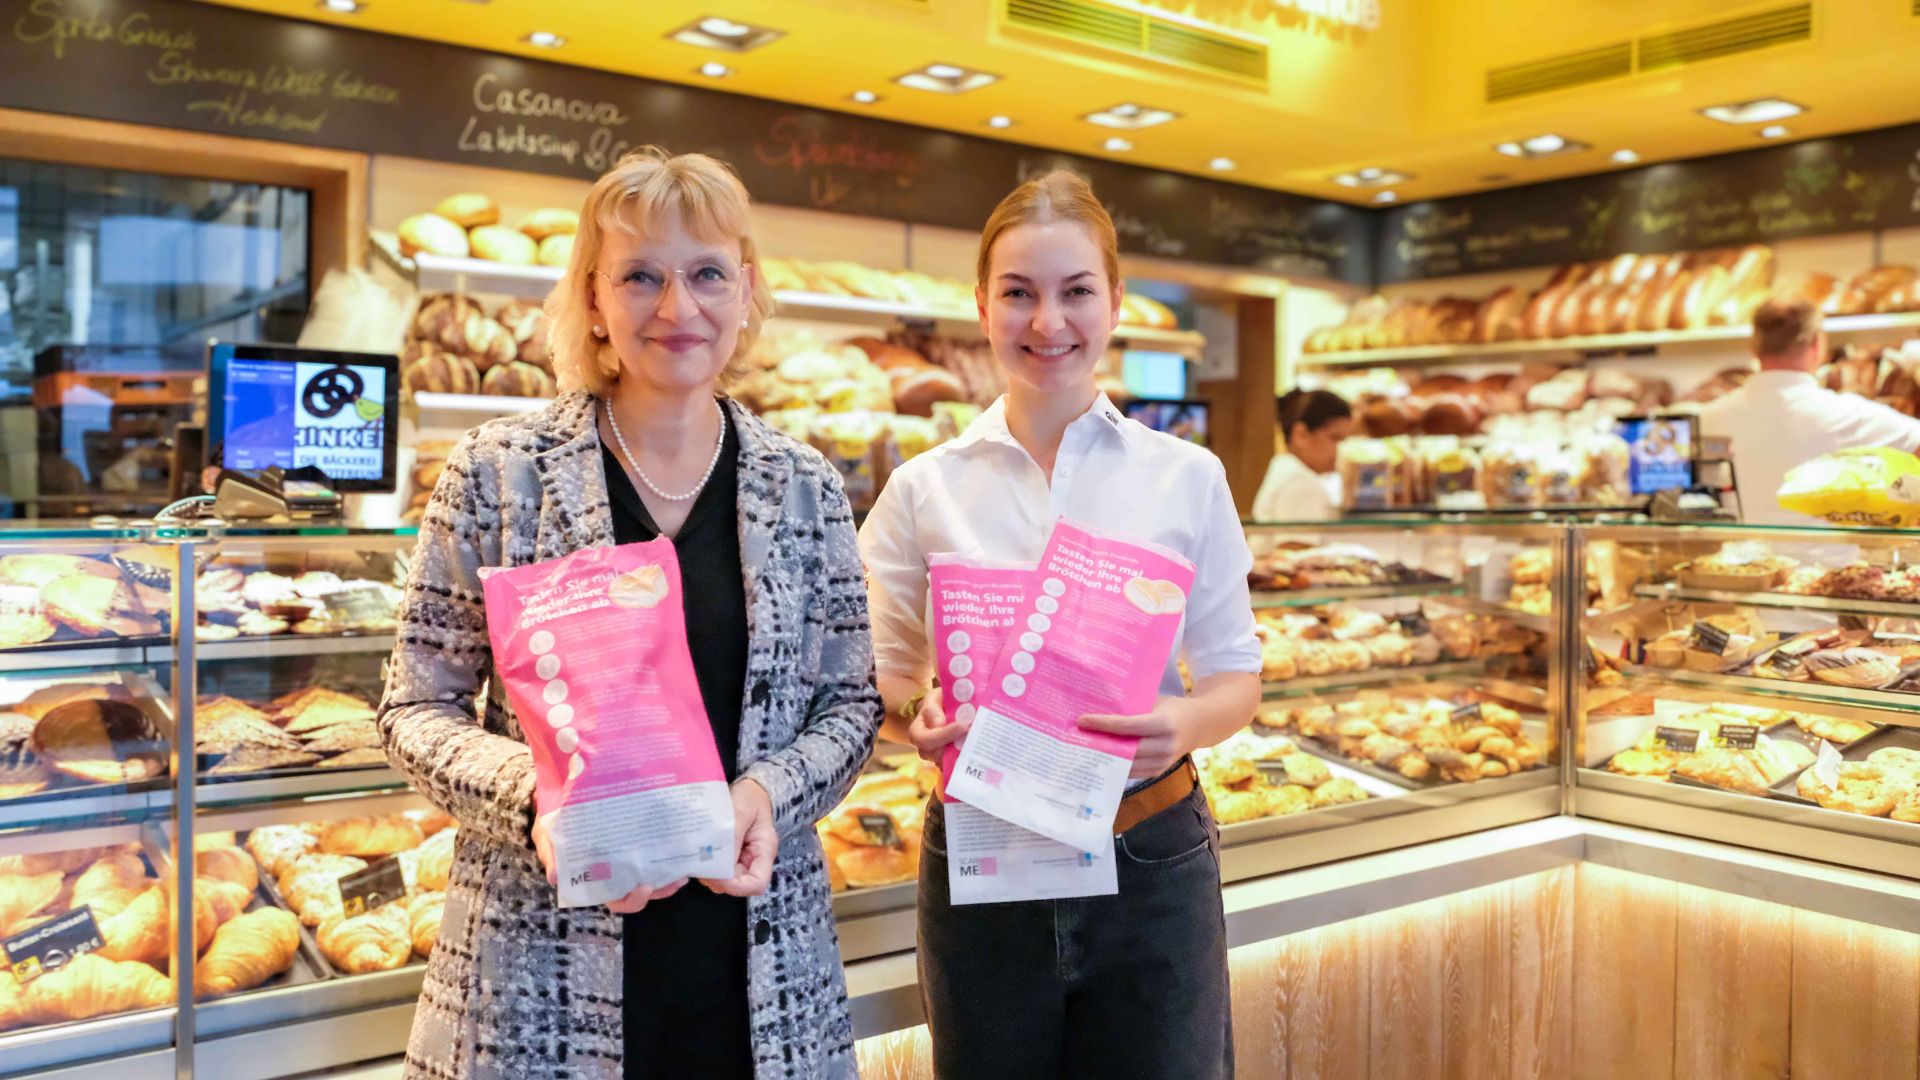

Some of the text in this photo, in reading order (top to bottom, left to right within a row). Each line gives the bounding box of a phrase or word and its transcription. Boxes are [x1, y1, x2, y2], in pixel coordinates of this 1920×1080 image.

[473, 72, 630, 125] Casanova
[322, 453, 377, 466] BÄCKEREI
[1057, 543, 1094, 567] Tasten
[1097, 559, 1116, 571] Sie
[1118, 565, 1144, 578] mal
[1052, 554, 1095, 578] wieder
[1097, 569, 1122, 583] Ihre
[565, 578, 589, 592] Sie
[1047, 562, 1121, 594] Brötchen ab
[941, 589, 980, 603] Tasten
[983, 592, 1003, 603] Sie
[942, 602, 1015, 615] wieder Ihre
[942, 613, 999, 628] Brötchen
[965, 765, 985, 781] ME
[570, 871, 593, 887] ME
[960, 866, 981, 877] ME
